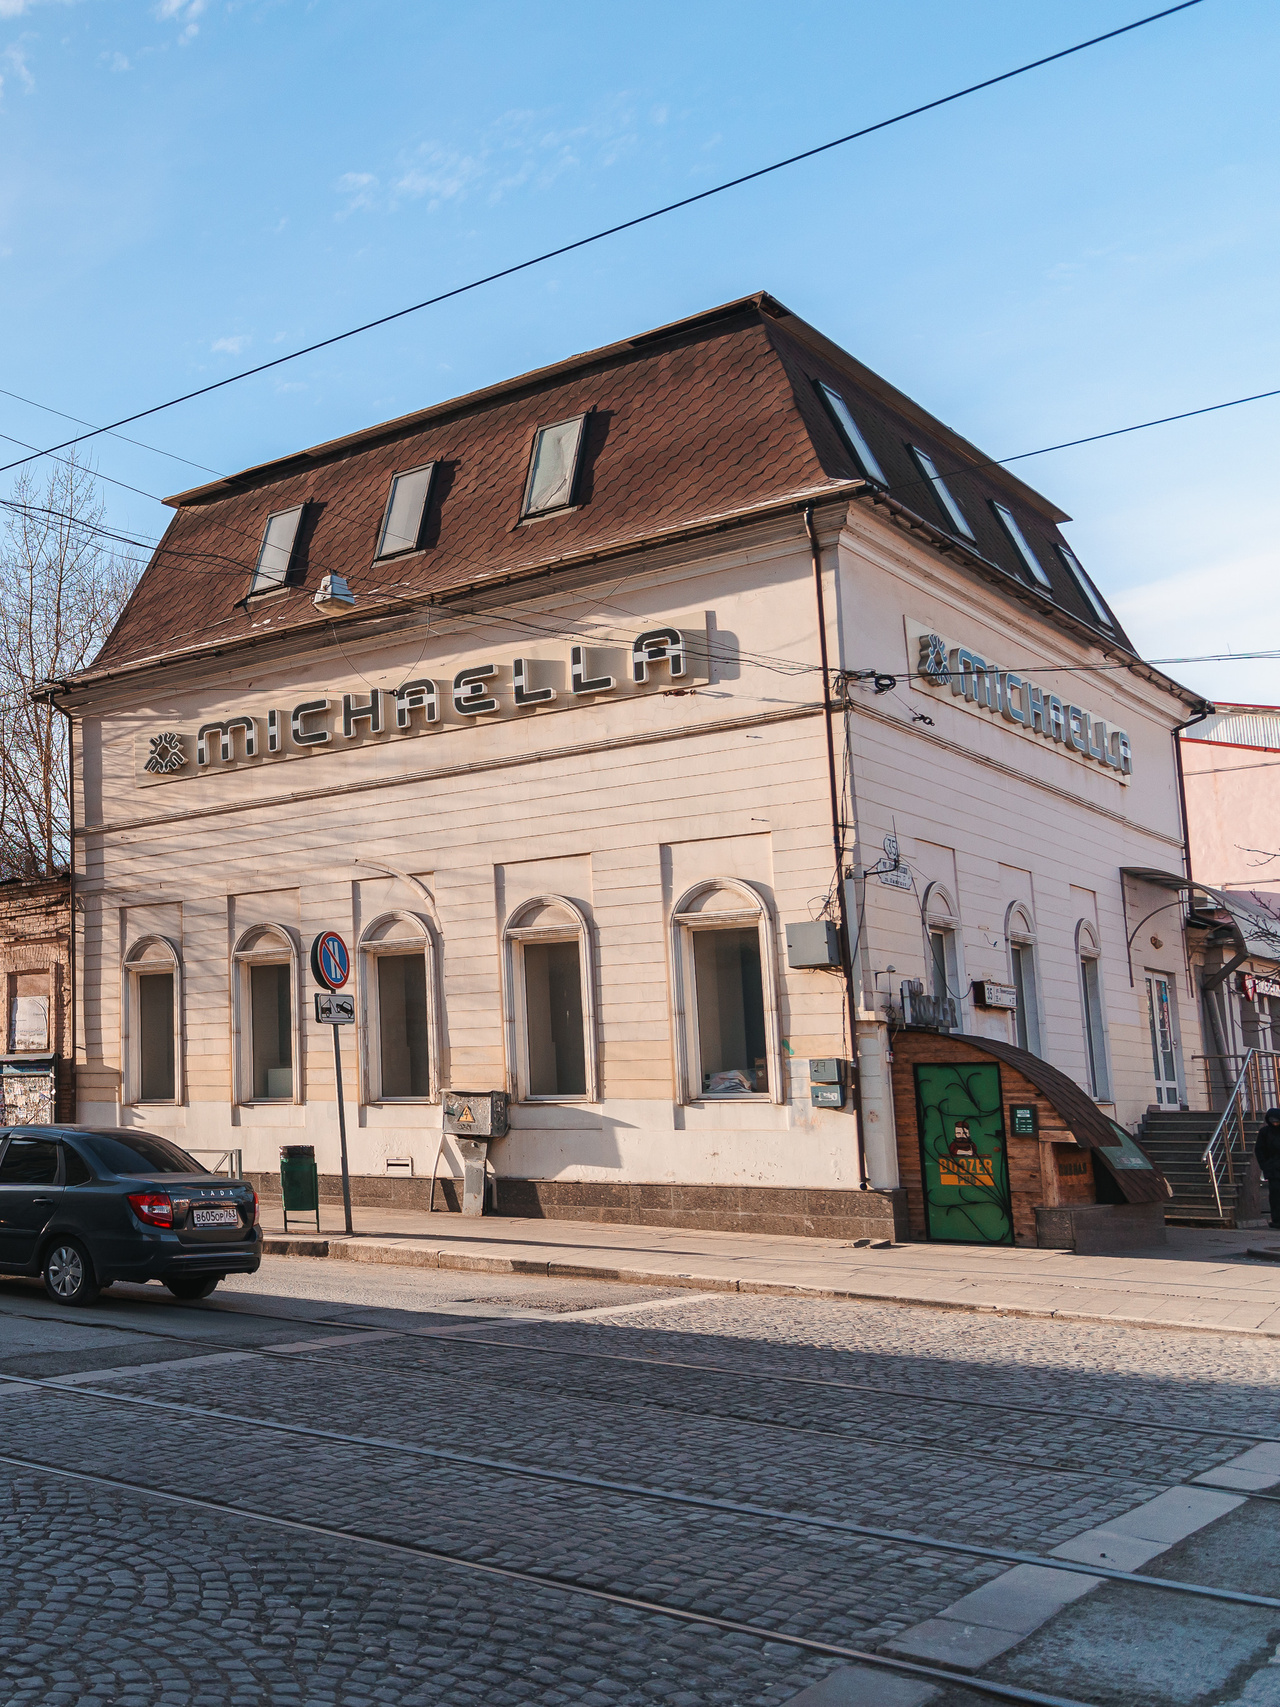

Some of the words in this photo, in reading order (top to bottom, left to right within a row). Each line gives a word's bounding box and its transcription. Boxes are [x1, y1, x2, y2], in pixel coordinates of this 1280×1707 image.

[197, 627, 688, 767] MICHAELLA
[950, 648, 1133, 776] MICHAELLA
[939, 1158, 993, 1175] BOOZER
